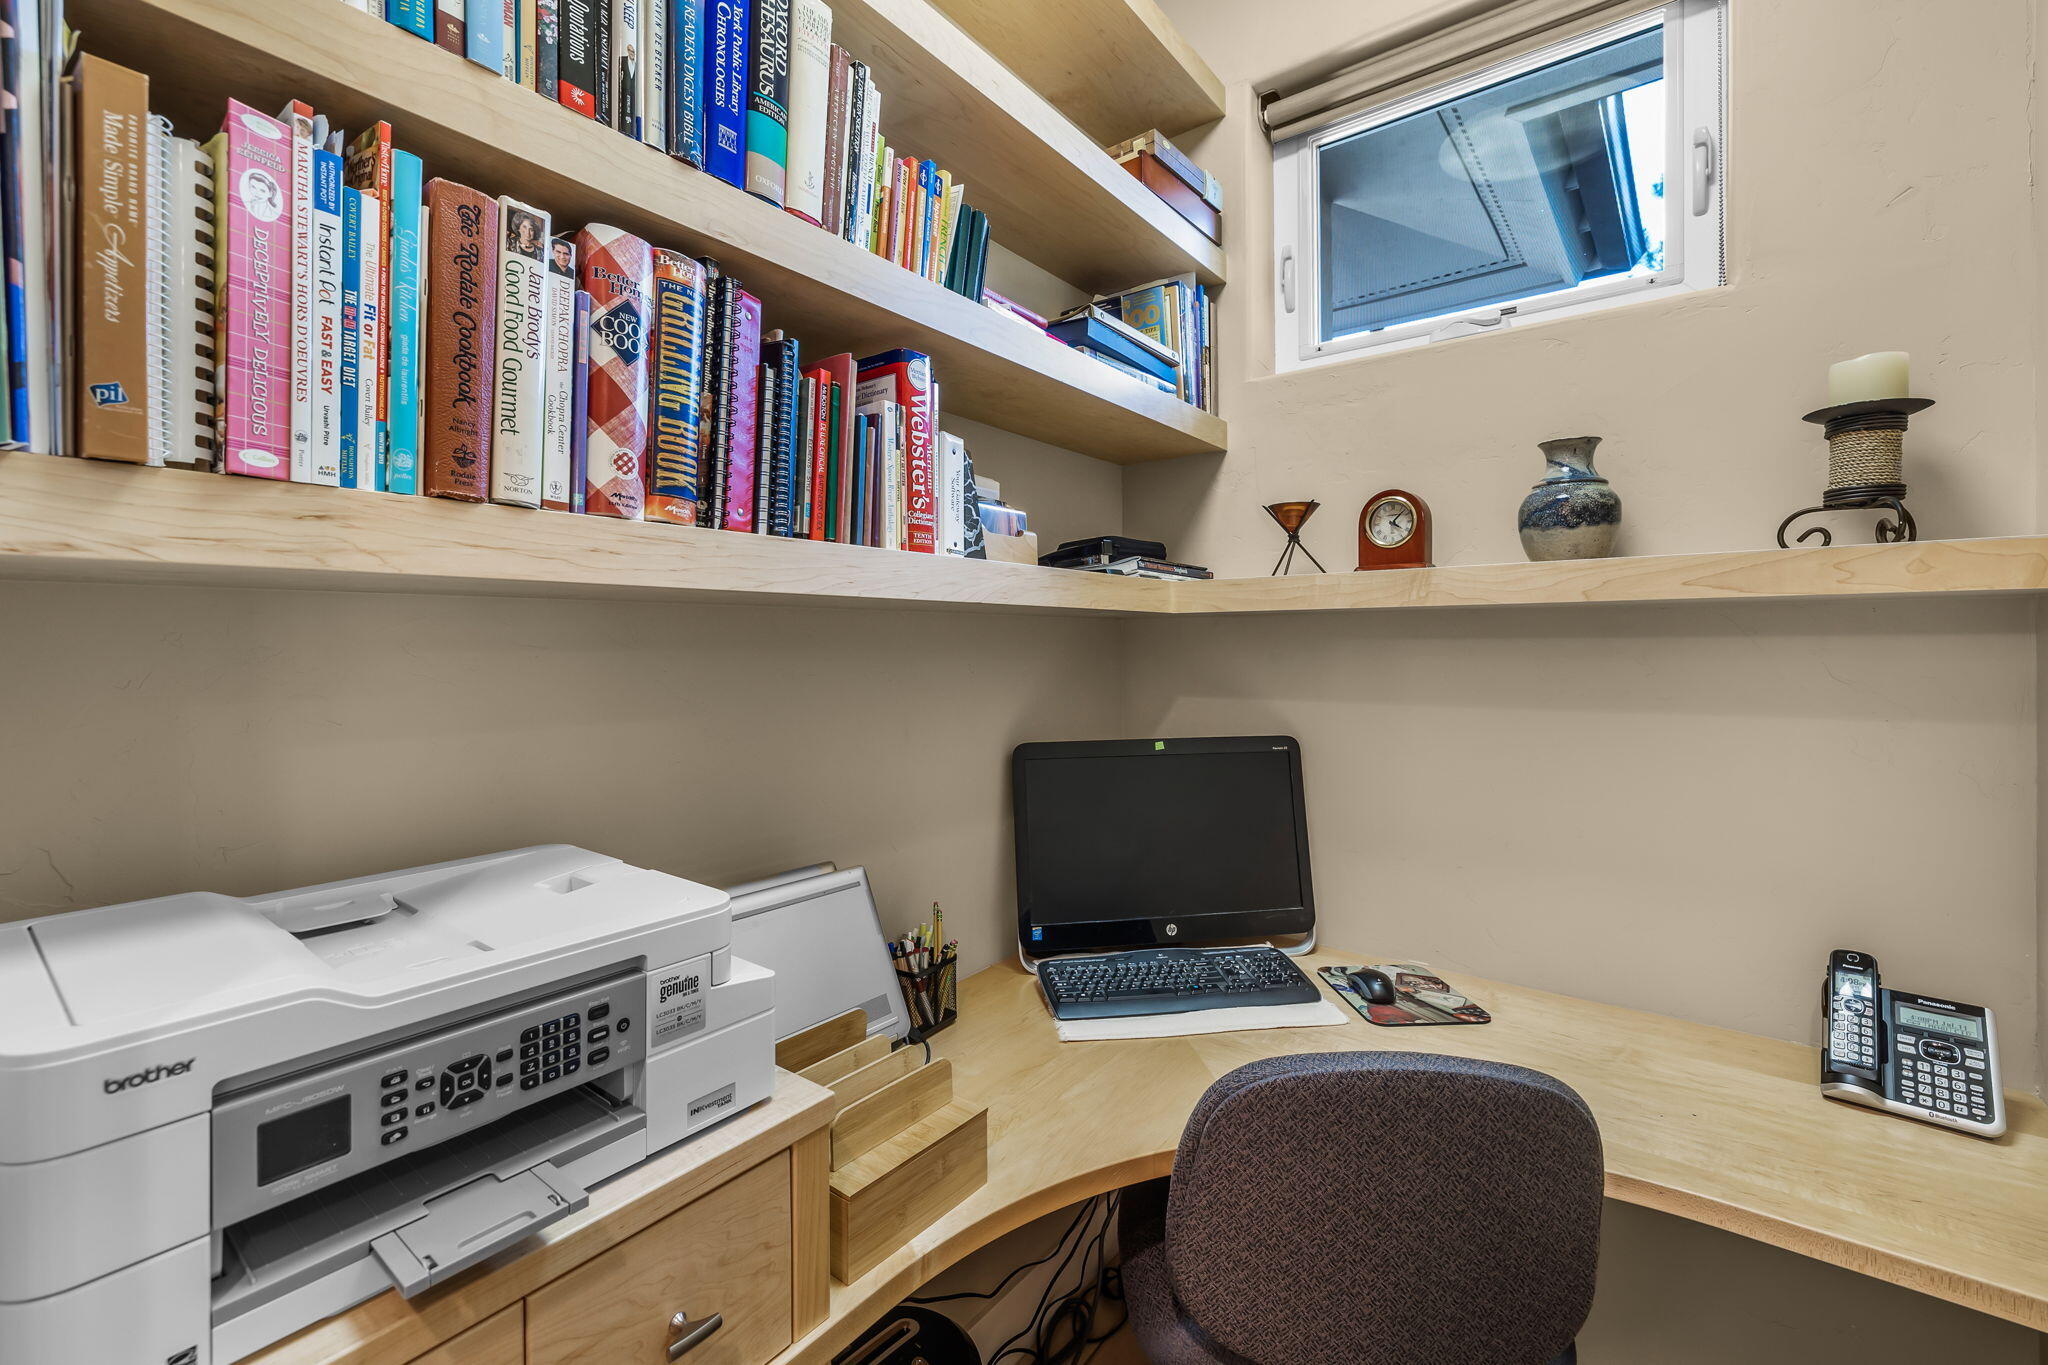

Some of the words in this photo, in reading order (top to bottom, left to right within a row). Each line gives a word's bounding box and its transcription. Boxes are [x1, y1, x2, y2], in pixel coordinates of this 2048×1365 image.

[624, 2, 635, 30] SLEEP
[733, 4, 744, 33] York
[655, 32, 663, 48] DE
[683, 5, 696, 63] READER'S
[759, 0, 776, 98] HESAURUS
[714, 1, 732, 108] CHRONOLOGIES
[732, 33, 743, 71] Public
[654, 49, 663, 92] BECKER
[683, 63, 695, 107] DIGEST
[729, 69, 742, 116] Library
[754, 96, 788, 121] AMERICAN
[102, 109, 124, 155] Made
[682, 109, 695, 149] BIBLE
[758, 105, 786, 127] EDITION
[297, 142, 308, 201] MARTHA
[320, 161, 328, 193] INSTANT
[328, 160, 336, 201] AUTHORIZED
[867, 152, 875, 183] FRENCH
[98, 158, 124, 215] Simple
[755, 174, 784, 196] OXFORD
[328, 200, 335, 211] BY
[348, 197, 357, 232] COVERT
[456, 202, 482, 237] The
[932, 201, 941, 238] Japanese
[296, 205, 308, 281] STEWART'S
[318, 223, 337, 276] Instant
[348, 233, 357, 259] BAILEY
[366, 242, 376, 258] The
[938, 219, 949, 264] FRENCH
[95, 222, 135, 324] Appetizers
[365, 260, 377, 301] Ultimate
[453, 243, 479, 310] Rodale
[592, 265, 641, 289] Better
[659, 254, 696, 274] Better
[252, 226, 270, 344] DECEPTIVELY
[318, 279, 337, 305] Pot
[344, 289, 357, 306] THE
[504, 259, 525, 307] Good
[527, 266, 544, 304] Jane
[661, 281, 683, 292] THE
[707, 281, 717, 301] The
[296, 283, 308, 322] HORS
[364, 303, 377, 321] Fit
[559, 279, 571, 324] DEEPAK
[619, 312, 638, 323] NEW
[321, 315, 333, 350] FAST
[363, 322, 374, 338] or
[502, 308, 524, 354] Food
[522, 305, 543, 360] Brody's
[705, 302, 716, 345] Redbook
[296, 324, 308, 403] D'OEUVRES
[321, 350, 332, 358] &
[343, 328, 357, 365] TARGET
[363, 339, 376, 360] Fat
[451, 310, 477, 410] Cookbook
[557, 324, 570, 373] CHOPRA
[658, 291, 704, 417] GRILLING
[251, 347, 270, 437] DELICIOUS
[320, 359, 333, 396] EASY
[342, 365, 356, 388] DIET
[365, 378, 374, 404] Covert
[95, 386, 123, 402] pil
[500, 357, 523, 436] Gourmet
[557, 390, 569, 423] Chopra
[861, 388, 889, 400] Dictionary
[363, 403, 374, 426] Bailey
[448, 425, 478, 437] Albright
[452, 417, 476, 429] Nancy
[546, 394, 556, 435] Cookbook
[556, 422, 568, 454] Center
[911, 395, 930, 509] Webster's
[656, 415, 699, 497] BOOK
[317, 470, 337, 478] HMH
[450, 469, 477, 481] Rodale
[454, 477, 474, 488] Press
[503, 485, 534, 495] NORTON
[912, 532, 933, 540] TENTH
[912, 538, 933, 546] EDITION
[659, 974, 681, 986] brother
[659, 975, 700, 1004] genuine
[1917, 998, 1957, 1011] Panasonic
[104, 1056, 198, 1095] brother
[461, 1078, 472, 1087] OK
[689, 1092, 733, 1117] INKvestment
